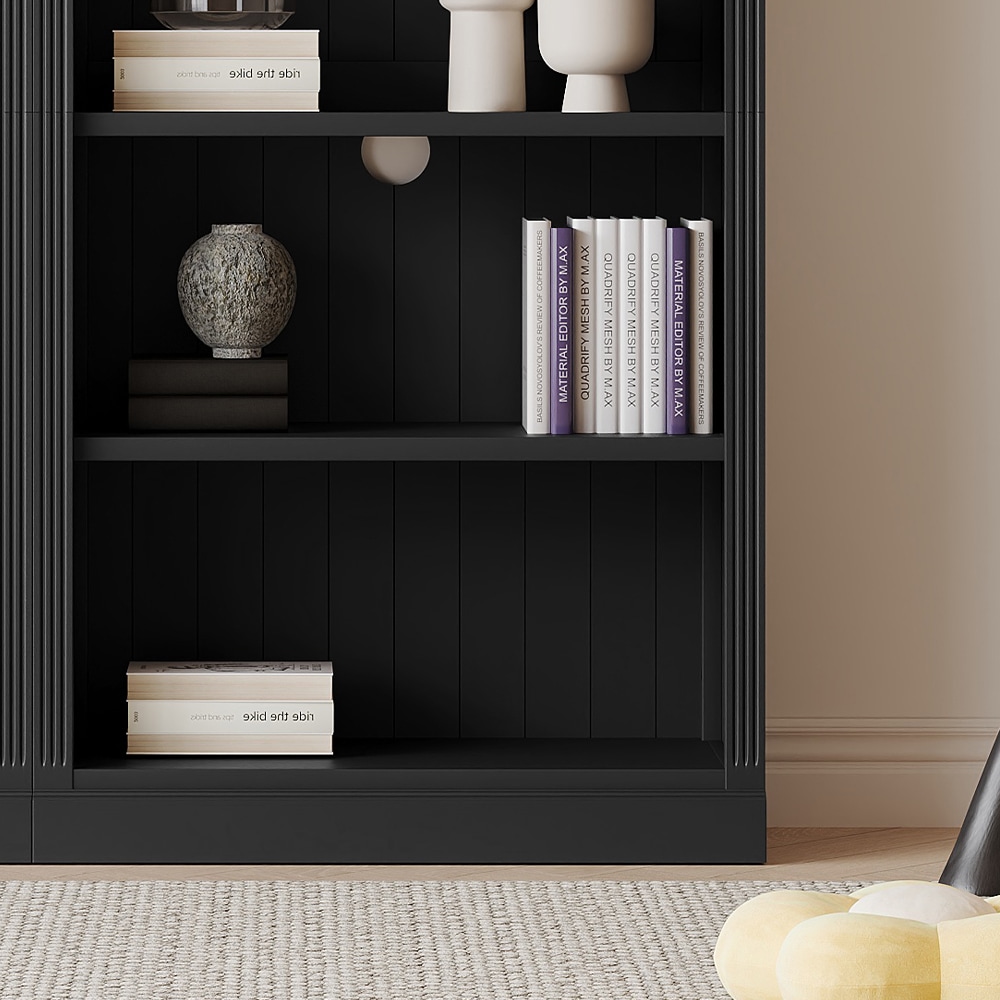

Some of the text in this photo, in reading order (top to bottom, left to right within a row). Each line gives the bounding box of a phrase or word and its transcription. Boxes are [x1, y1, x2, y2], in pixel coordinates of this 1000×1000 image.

[537, 293, 543, 303] OF
[559, 246, 567, 403] MATERIAL EDITOR BY M.AX
[581, 246, 590, 400] QUADRIFY MESH BY M.AX
[604, 253, 612, 408] QUADRIFY MESH BY M.AX
[627, 253, 636, 408] QUADRIFY MESH BY M.AX
[650, 253, 659, 408] QUADRIFY MESH BY M.AX
[674, 260, 683, 417] MATERIAL EDITOR BY M.AX
[698, 351, 704, 362] OF
